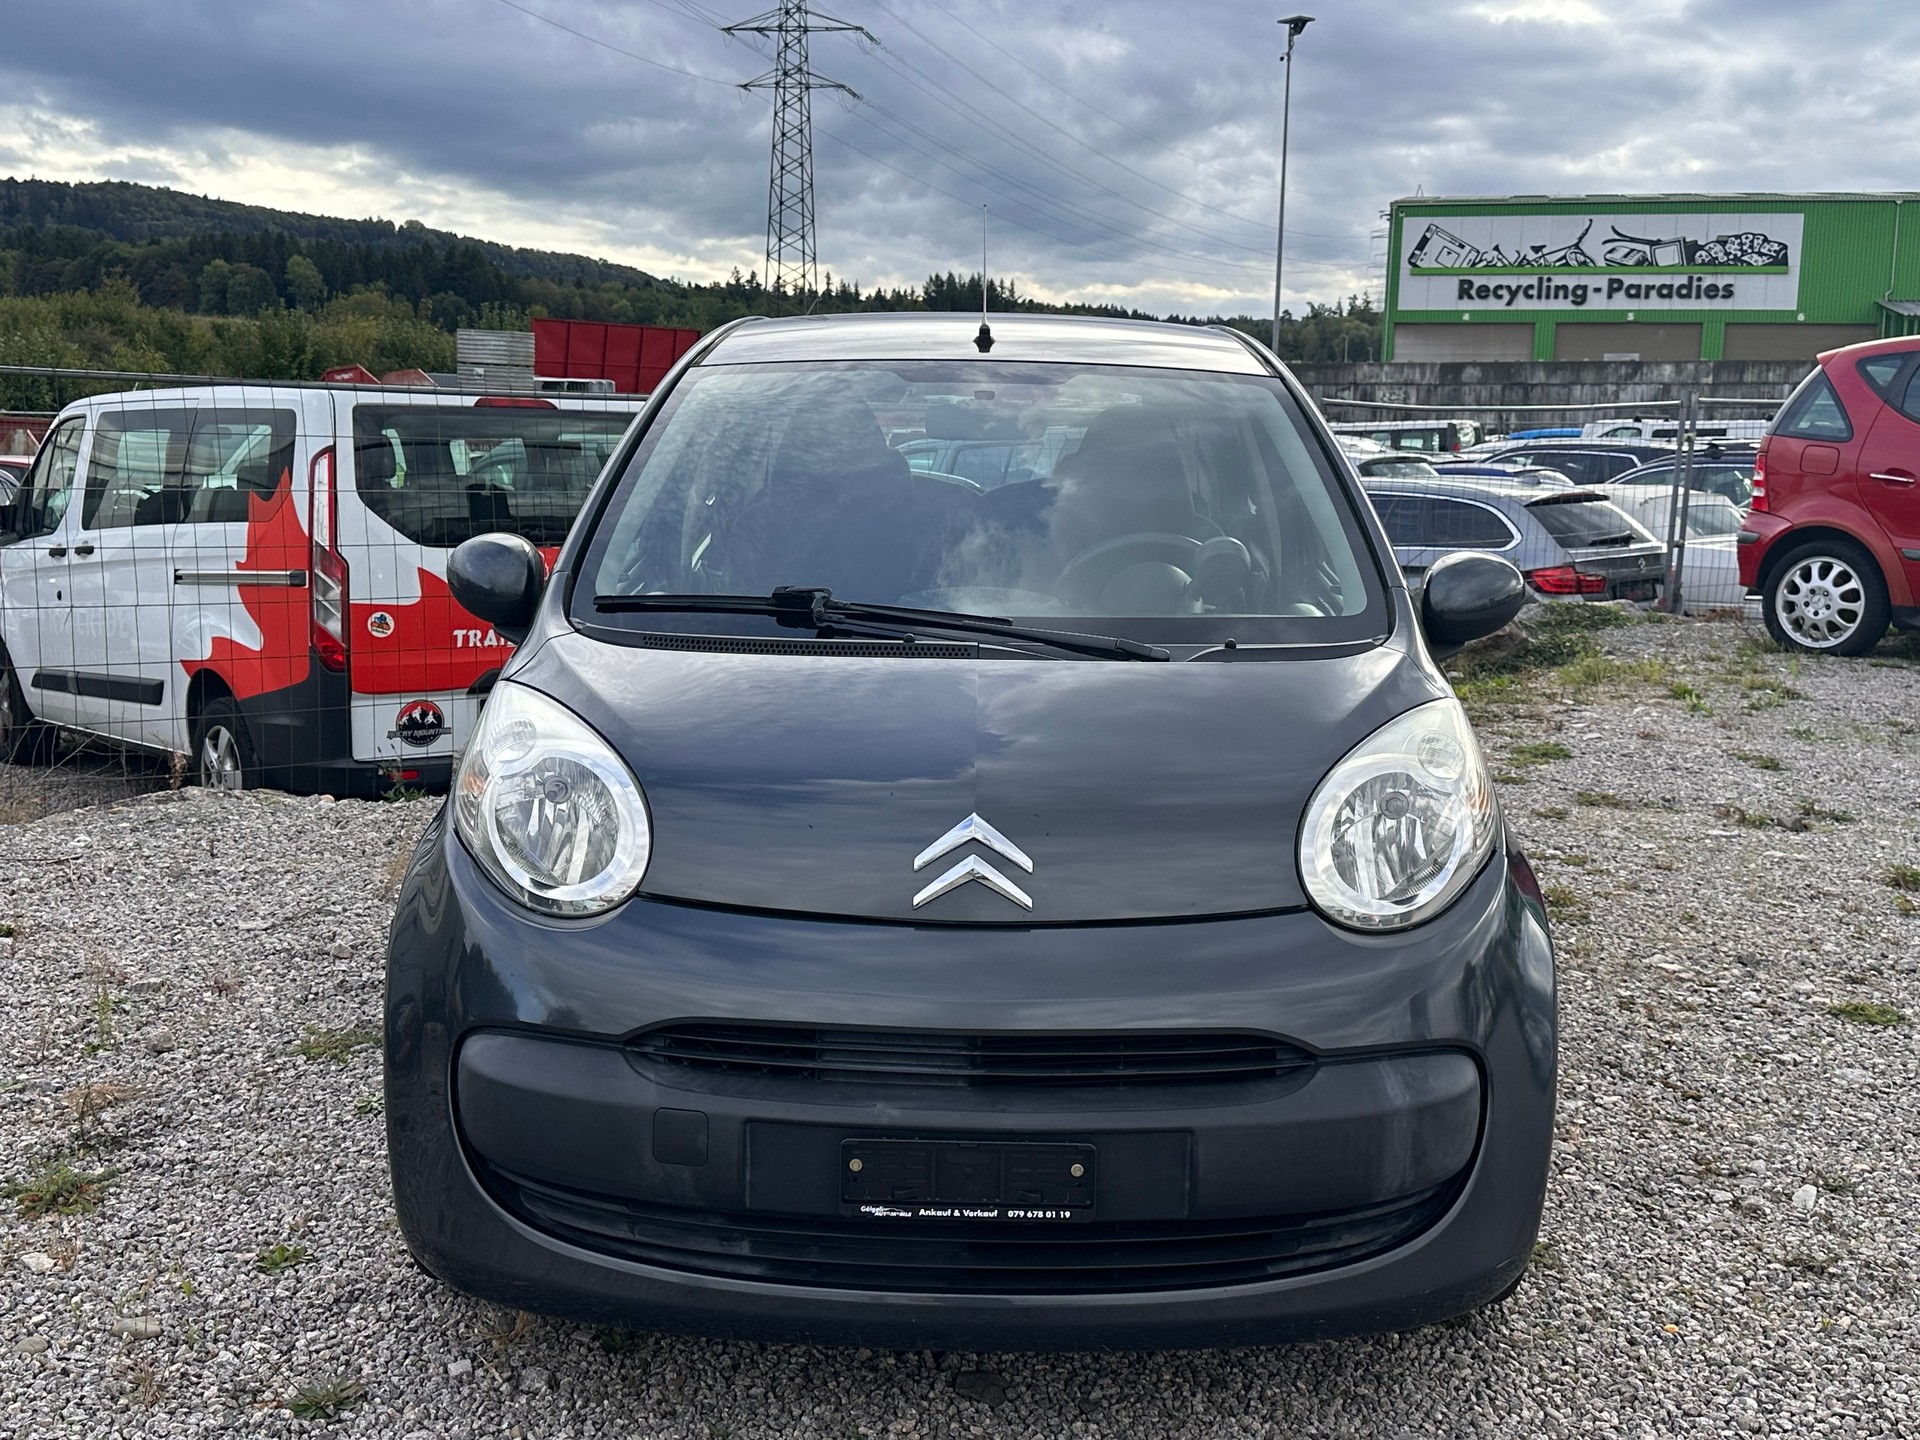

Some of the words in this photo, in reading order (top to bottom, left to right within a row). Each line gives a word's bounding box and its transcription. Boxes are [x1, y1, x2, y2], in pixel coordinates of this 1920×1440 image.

[918, 1208, 951, 1217] Ankauf
[953, 1209, 961, 1217] &
[963, 1209, 998, 1218] Verkauf
[1007, 1210, 1025, 1218] 079
[1026, 1210, 1044, 1219] 678
[1045, 1210, 1056, 1219] 01
[1059, 1210, 1071, 1219] 19
